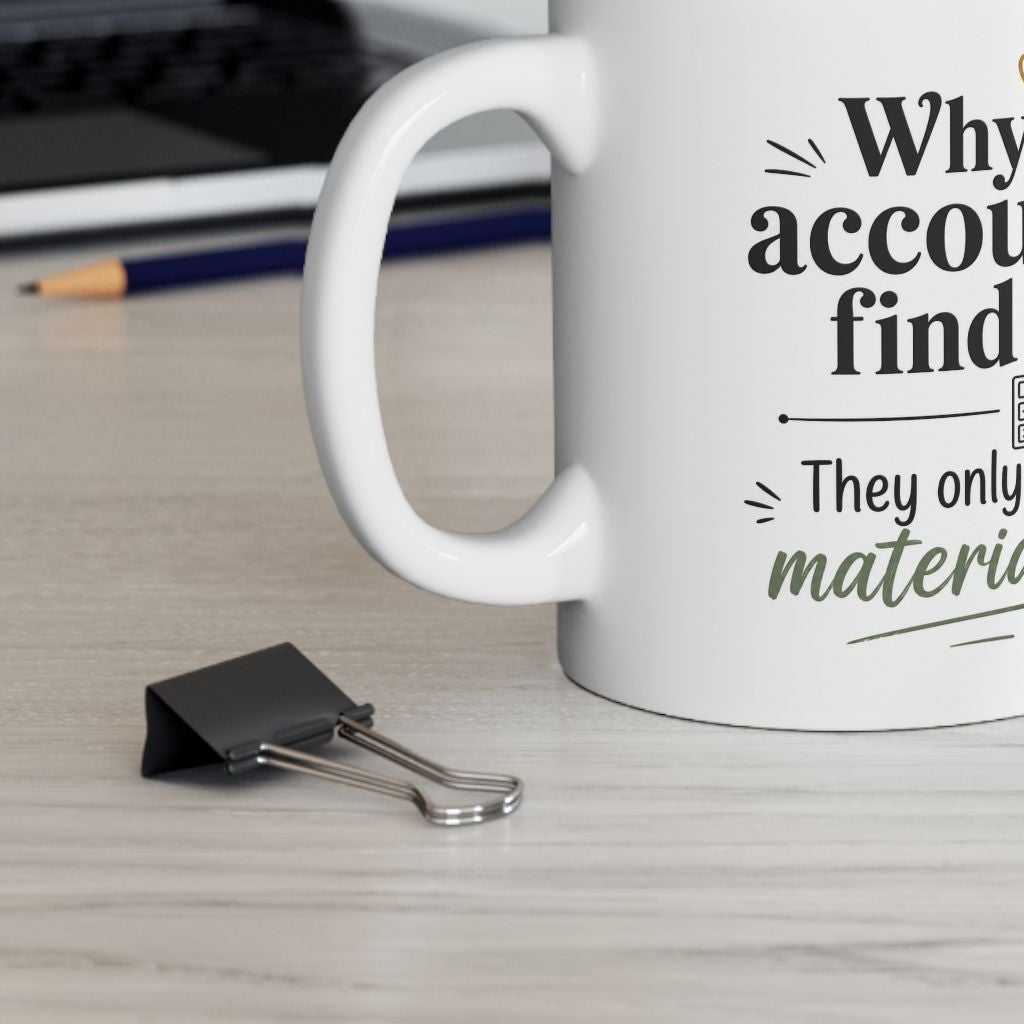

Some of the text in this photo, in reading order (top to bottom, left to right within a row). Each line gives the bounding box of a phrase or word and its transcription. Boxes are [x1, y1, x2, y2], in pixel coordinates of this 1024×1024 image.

[829, 277, 1018, 376] find
[800, 457, 918, 527] They
[937, 448, 1022, 517] only
